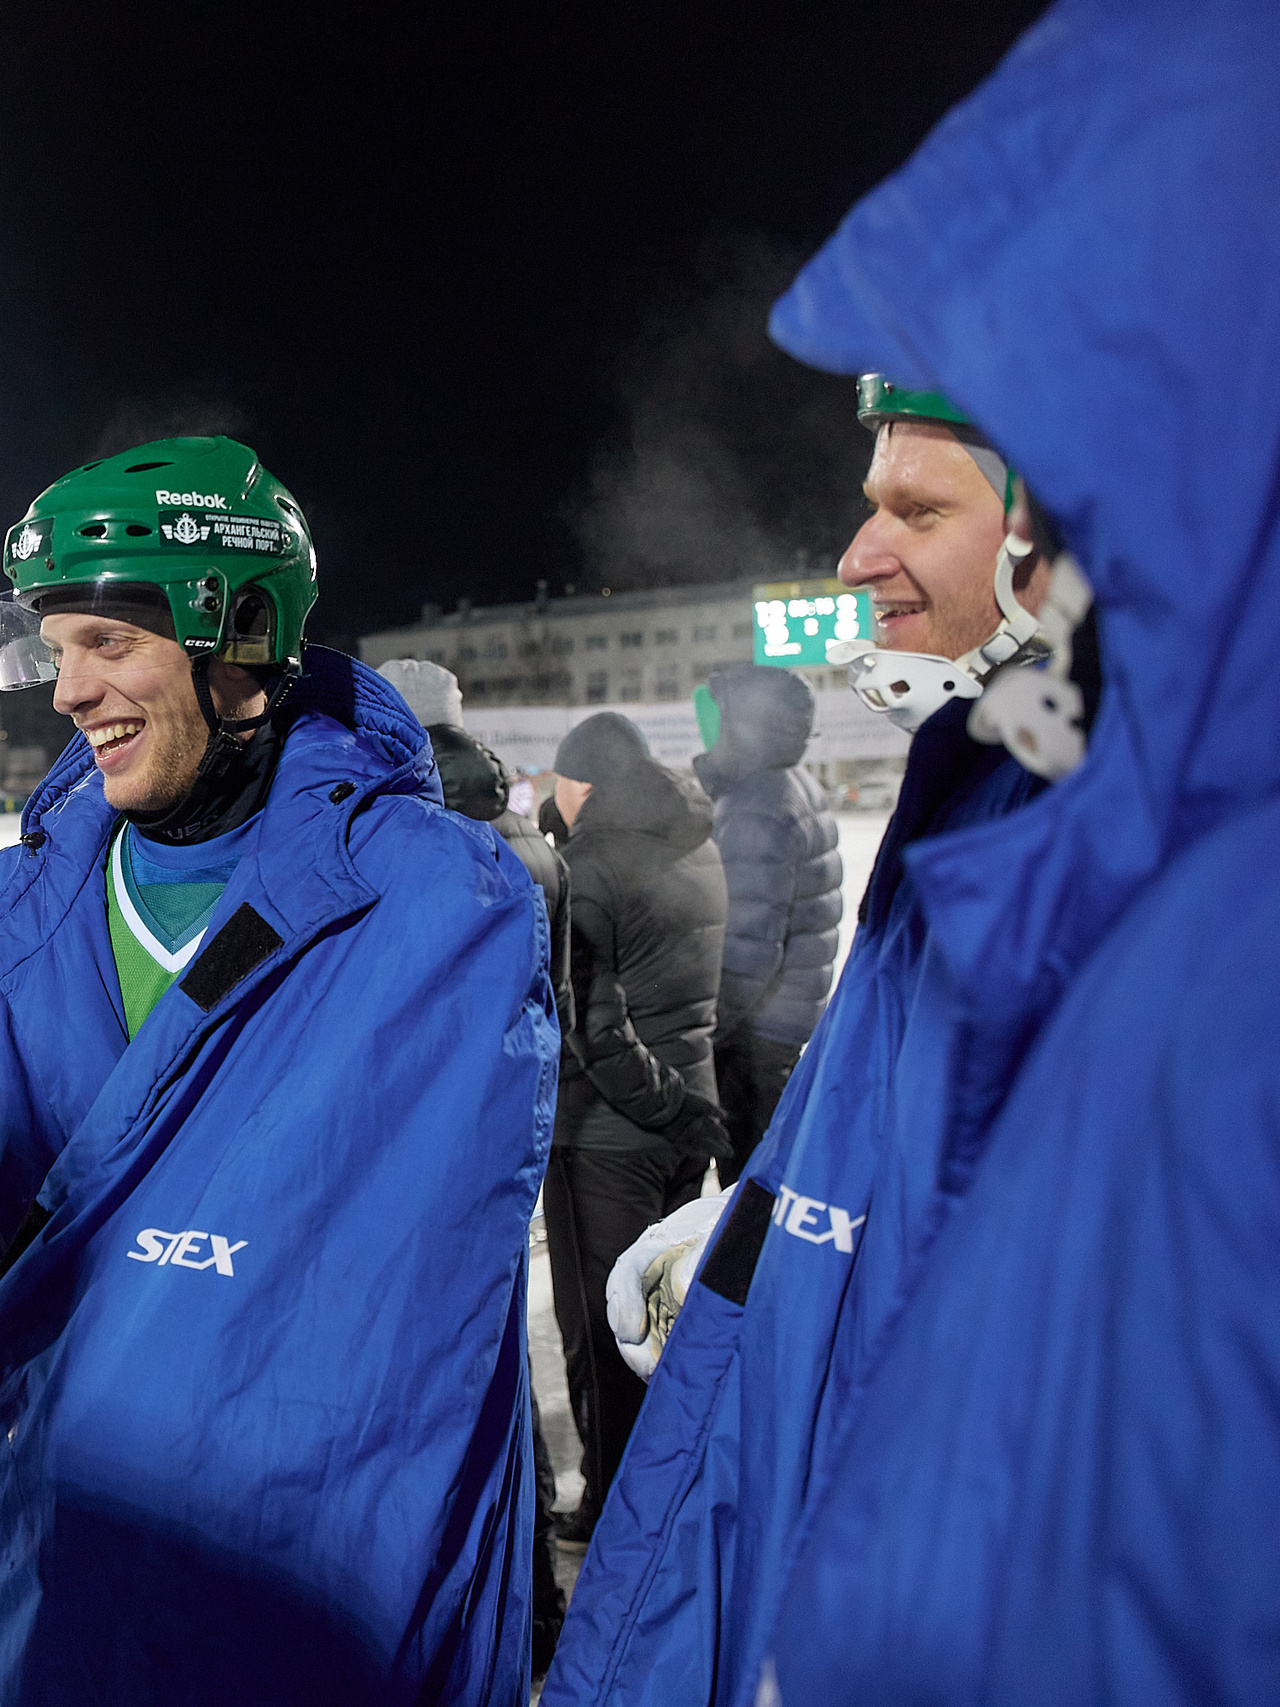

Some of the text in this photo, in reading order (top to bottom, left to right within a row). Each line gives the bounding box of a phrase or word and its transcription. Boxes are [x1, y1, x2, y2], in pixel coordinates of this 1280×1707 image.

[155, 489, 228, 510] Reebok
[213, 522, 280, 541] АРХАНГЕЛЬСКИЙ
[222, 535, 274, 552] РЕЧНОЙ ПОРТ
[184, 639, 216, 648] CCM
[126, 1228, 249, 1277] STEX
